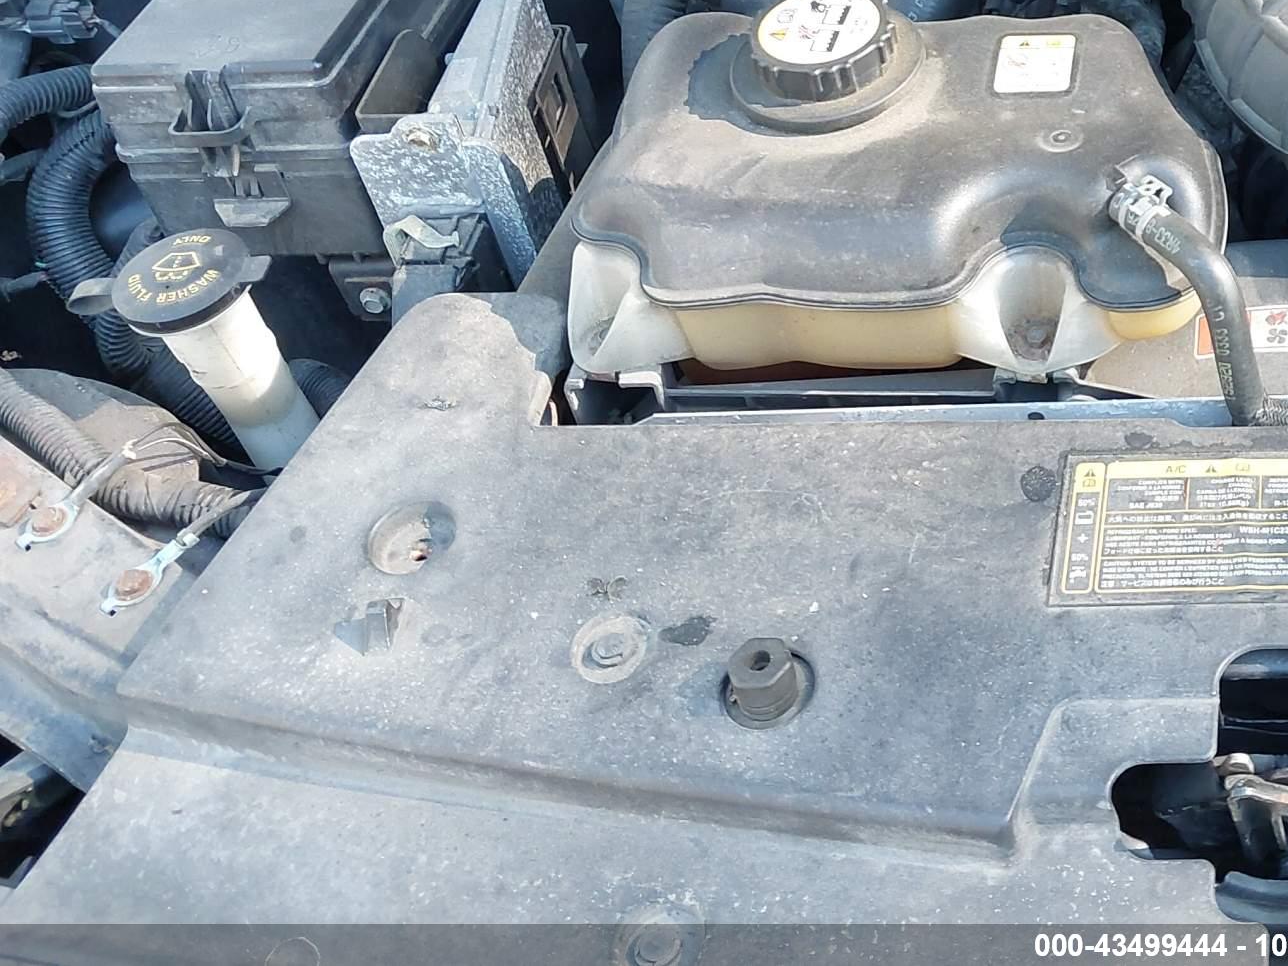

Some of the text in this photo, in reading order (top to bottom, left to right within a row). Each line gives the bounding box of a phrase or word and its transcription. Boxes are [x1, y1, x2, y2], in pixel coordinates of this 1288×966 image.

[173, 235, 211, 246] ONLY
[128, 269, 220, 303] WASHER FLUID
